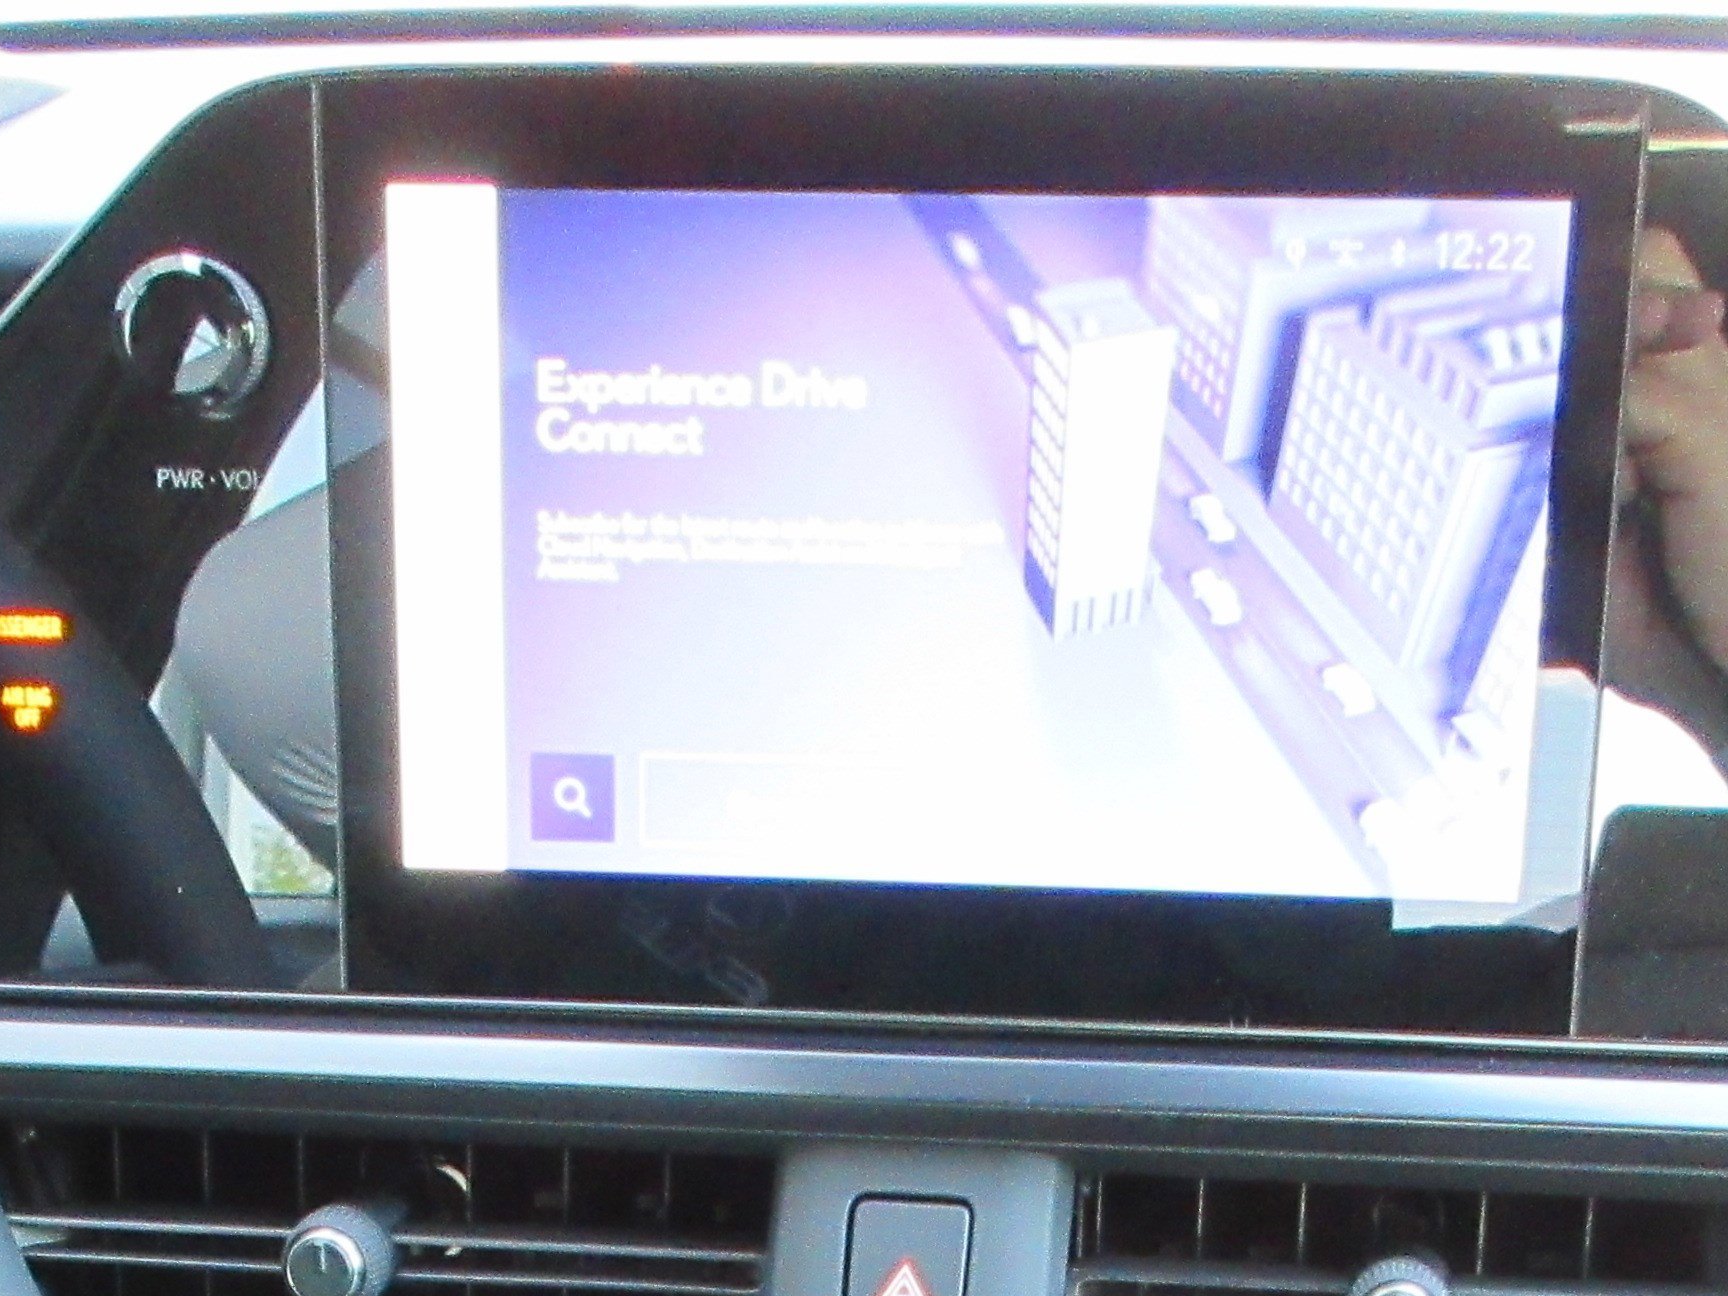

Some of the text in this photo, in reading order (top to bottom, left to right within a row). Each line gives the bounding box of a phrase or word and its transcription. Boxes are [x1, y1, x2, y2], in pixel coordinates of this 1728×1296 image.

[1435, 228, 1535, 272] 12:22
[536, 358, 869, 414] Experience Drive
[535, 406, 704, 455] Connect
[156, 468, 205, 489] PWR
